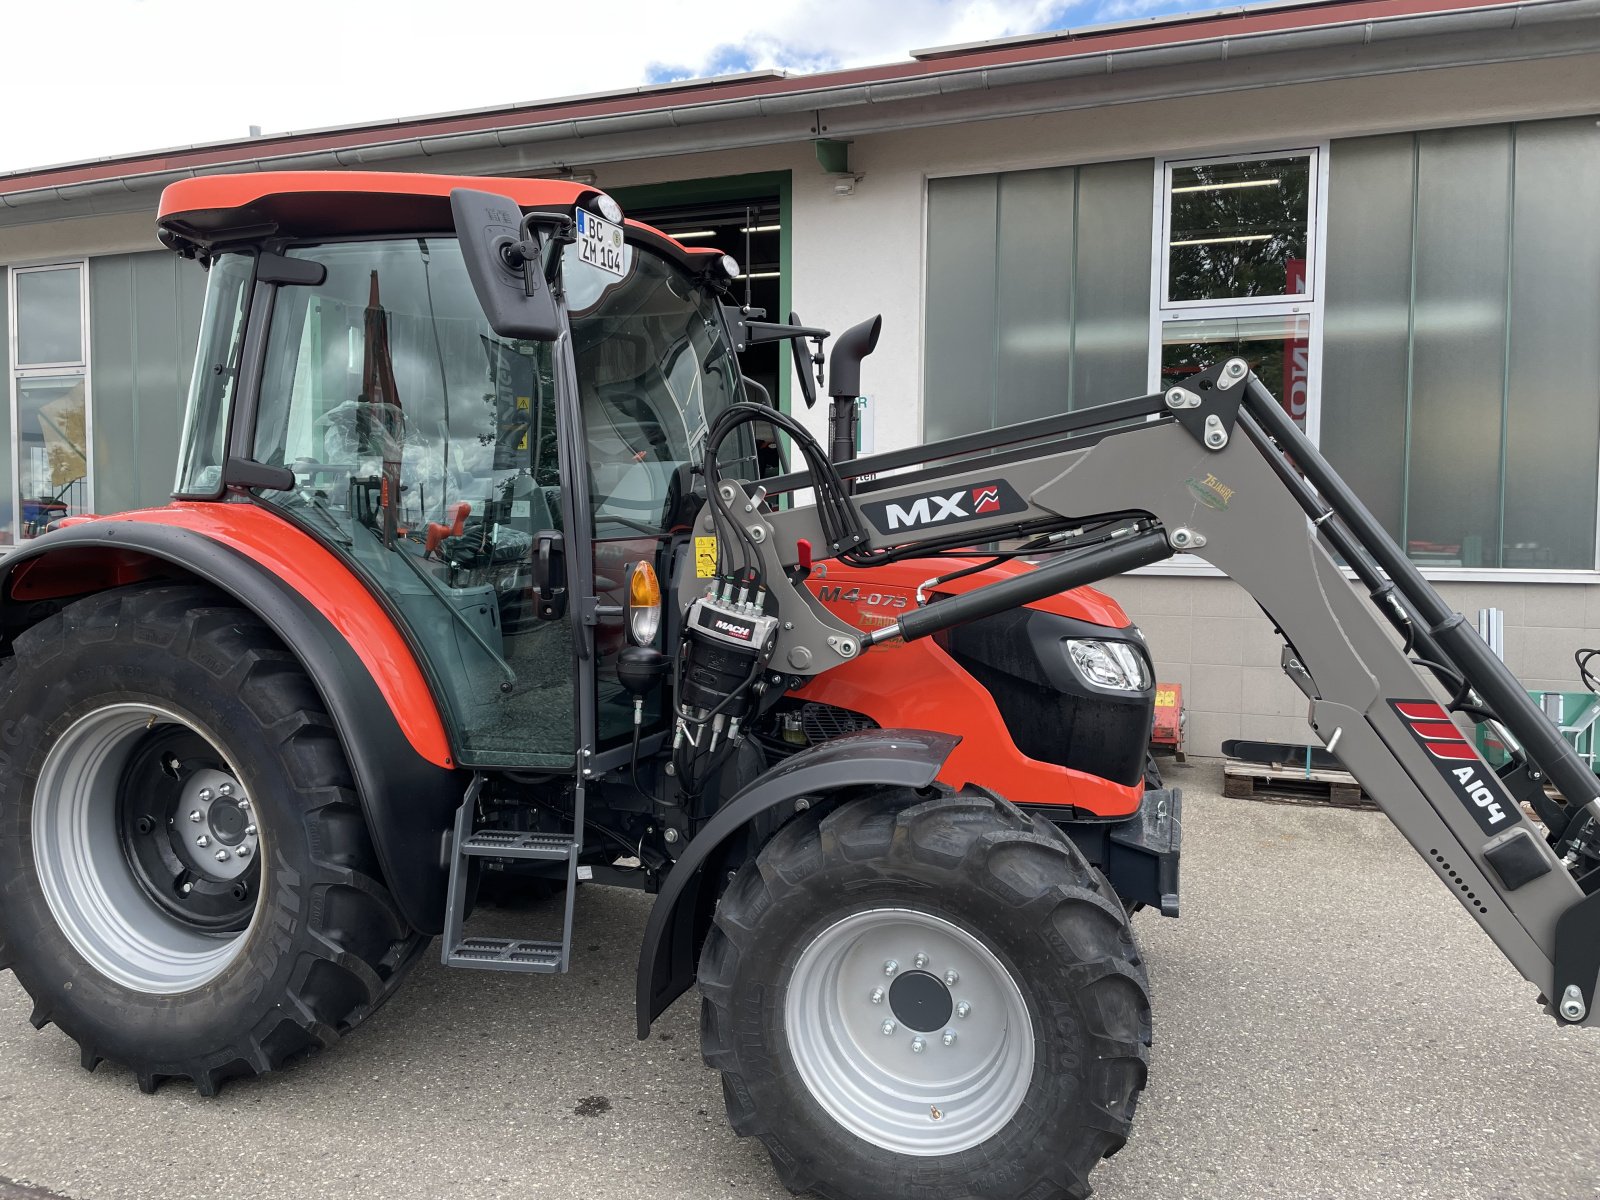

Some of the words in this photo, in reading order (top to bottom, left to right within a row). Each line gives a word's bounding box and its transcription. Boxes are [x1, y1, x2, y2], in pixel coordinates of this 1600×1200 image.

[589, 217, 603, 243] BC
[582, 238, 597, 264] ZM
[600, 246, 621, 272] 104
[886, 490, 970, 530] MX
[715, 620, 751, 636] MACH
[1451, 766, 1507, 825] A104
